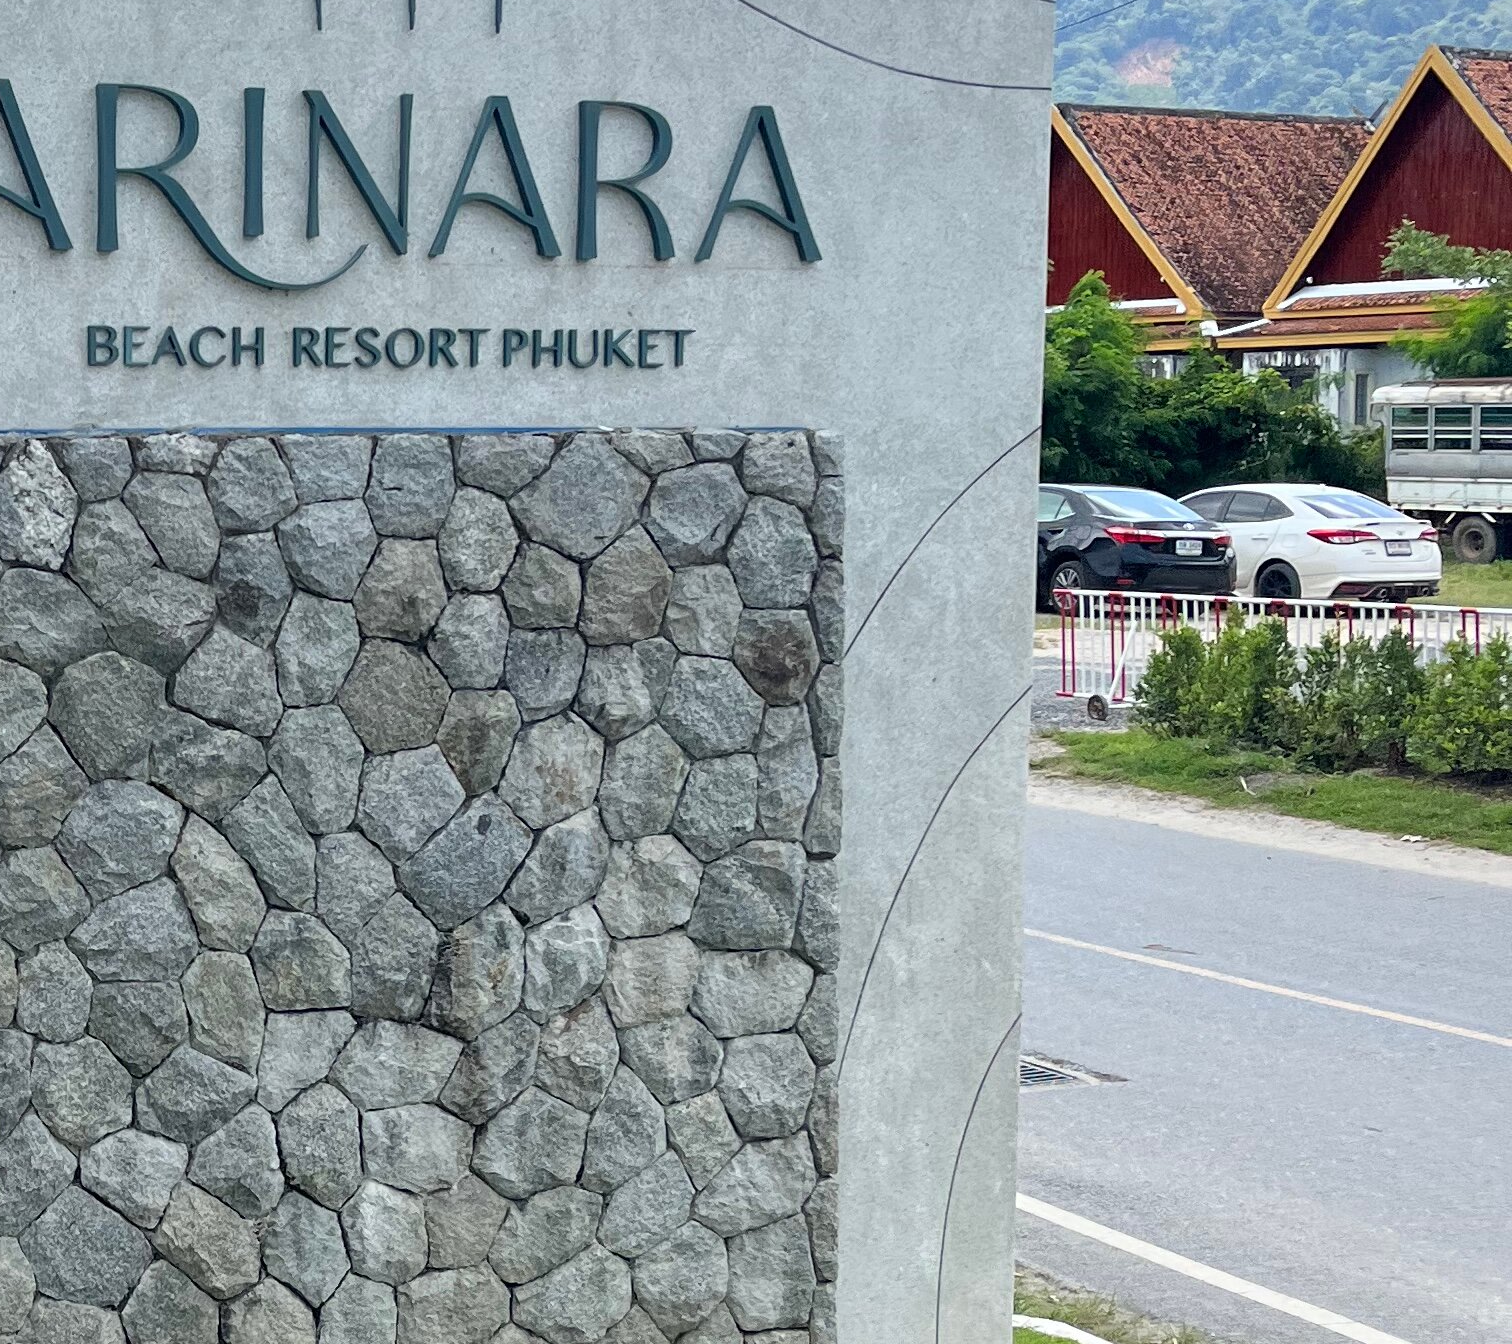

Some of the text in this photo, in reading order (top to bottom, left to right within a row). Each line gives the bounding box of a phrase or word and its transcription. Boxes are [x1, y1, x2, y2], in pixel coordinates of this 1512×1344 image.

[86, 325, 697, 371] BEACH RESORT PHUKET
